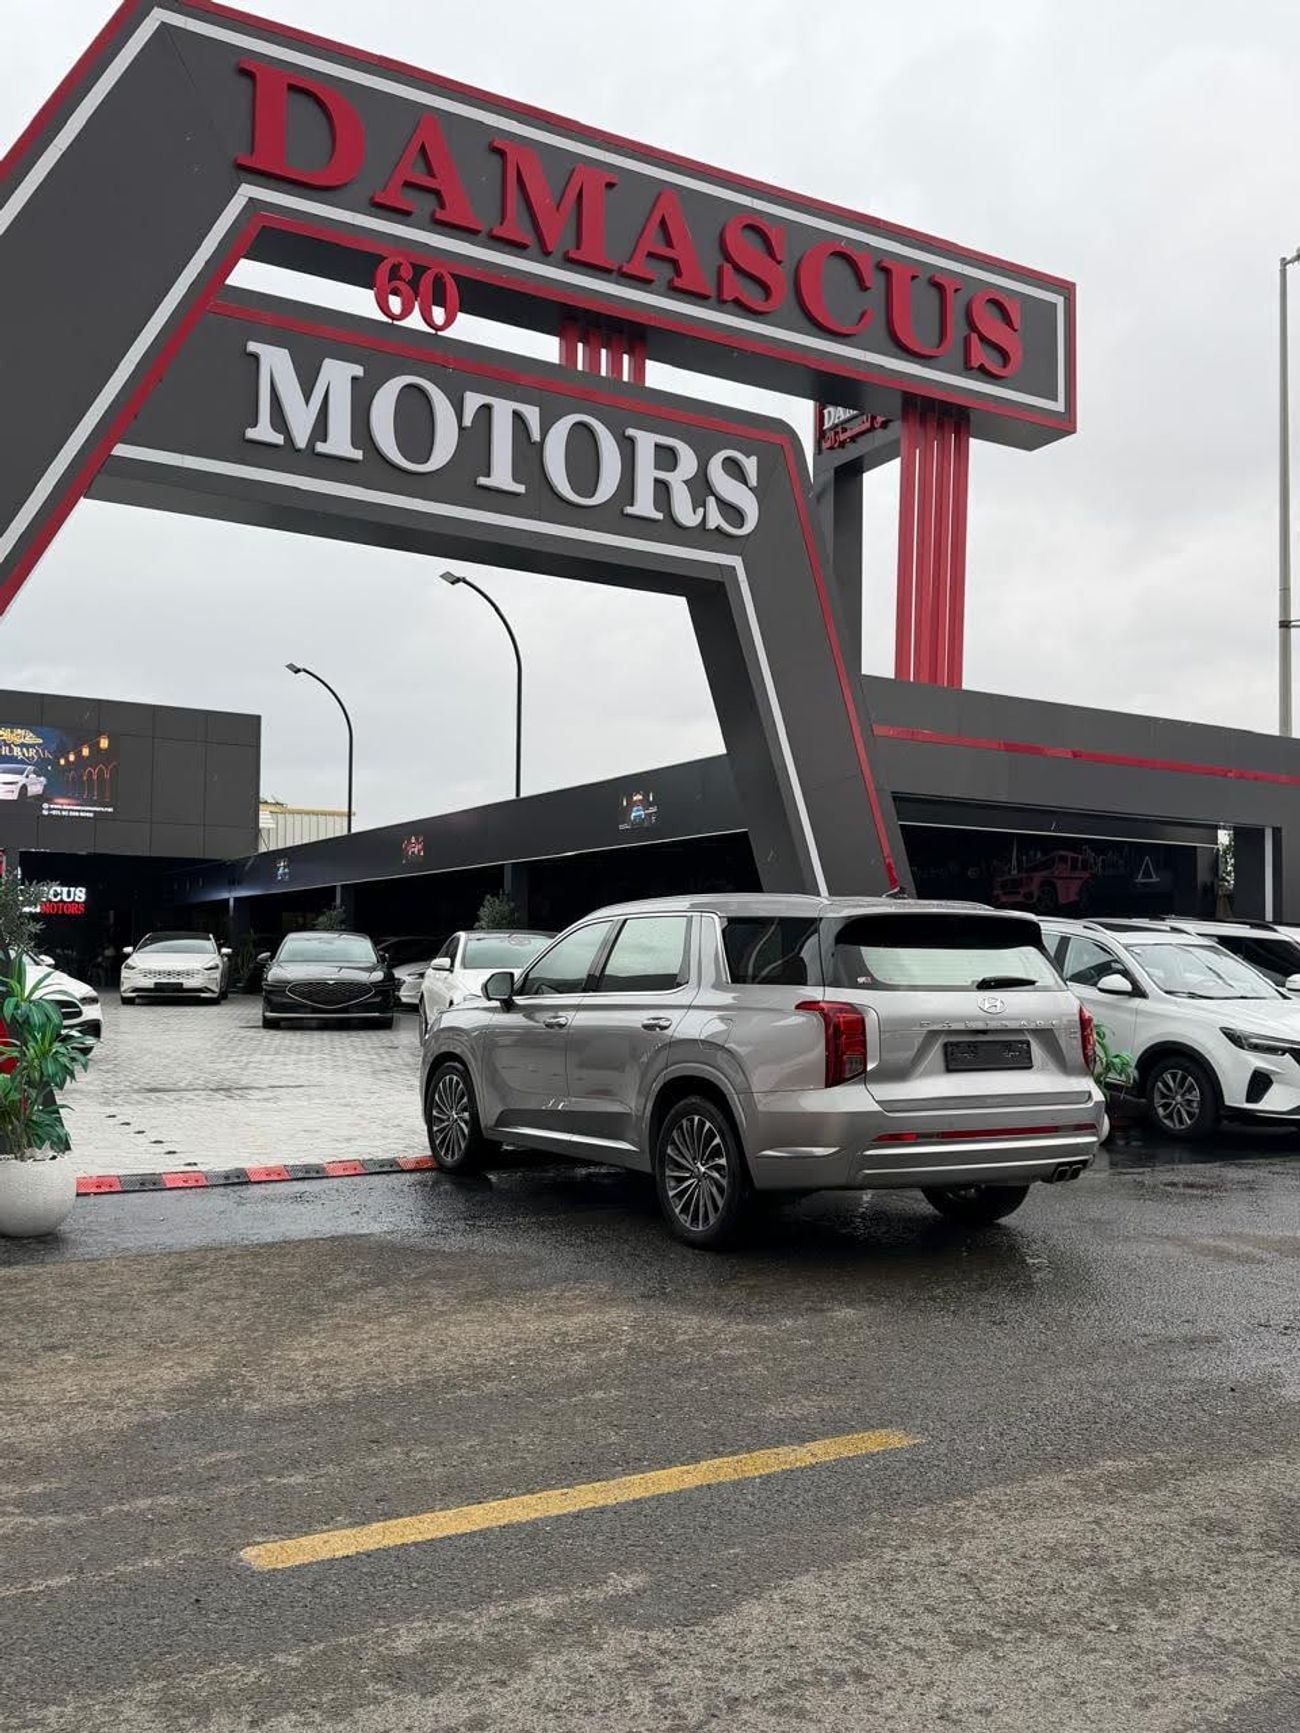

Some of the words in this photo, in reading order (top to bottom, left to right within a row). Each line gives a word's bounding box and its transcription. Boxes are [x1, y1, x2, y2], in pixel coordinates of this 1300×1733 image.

[235, 58, 1023, 379] DAMASCUS
[373, 256, 460, 332] 60
[243, 340, 760, 537] MOTORS
